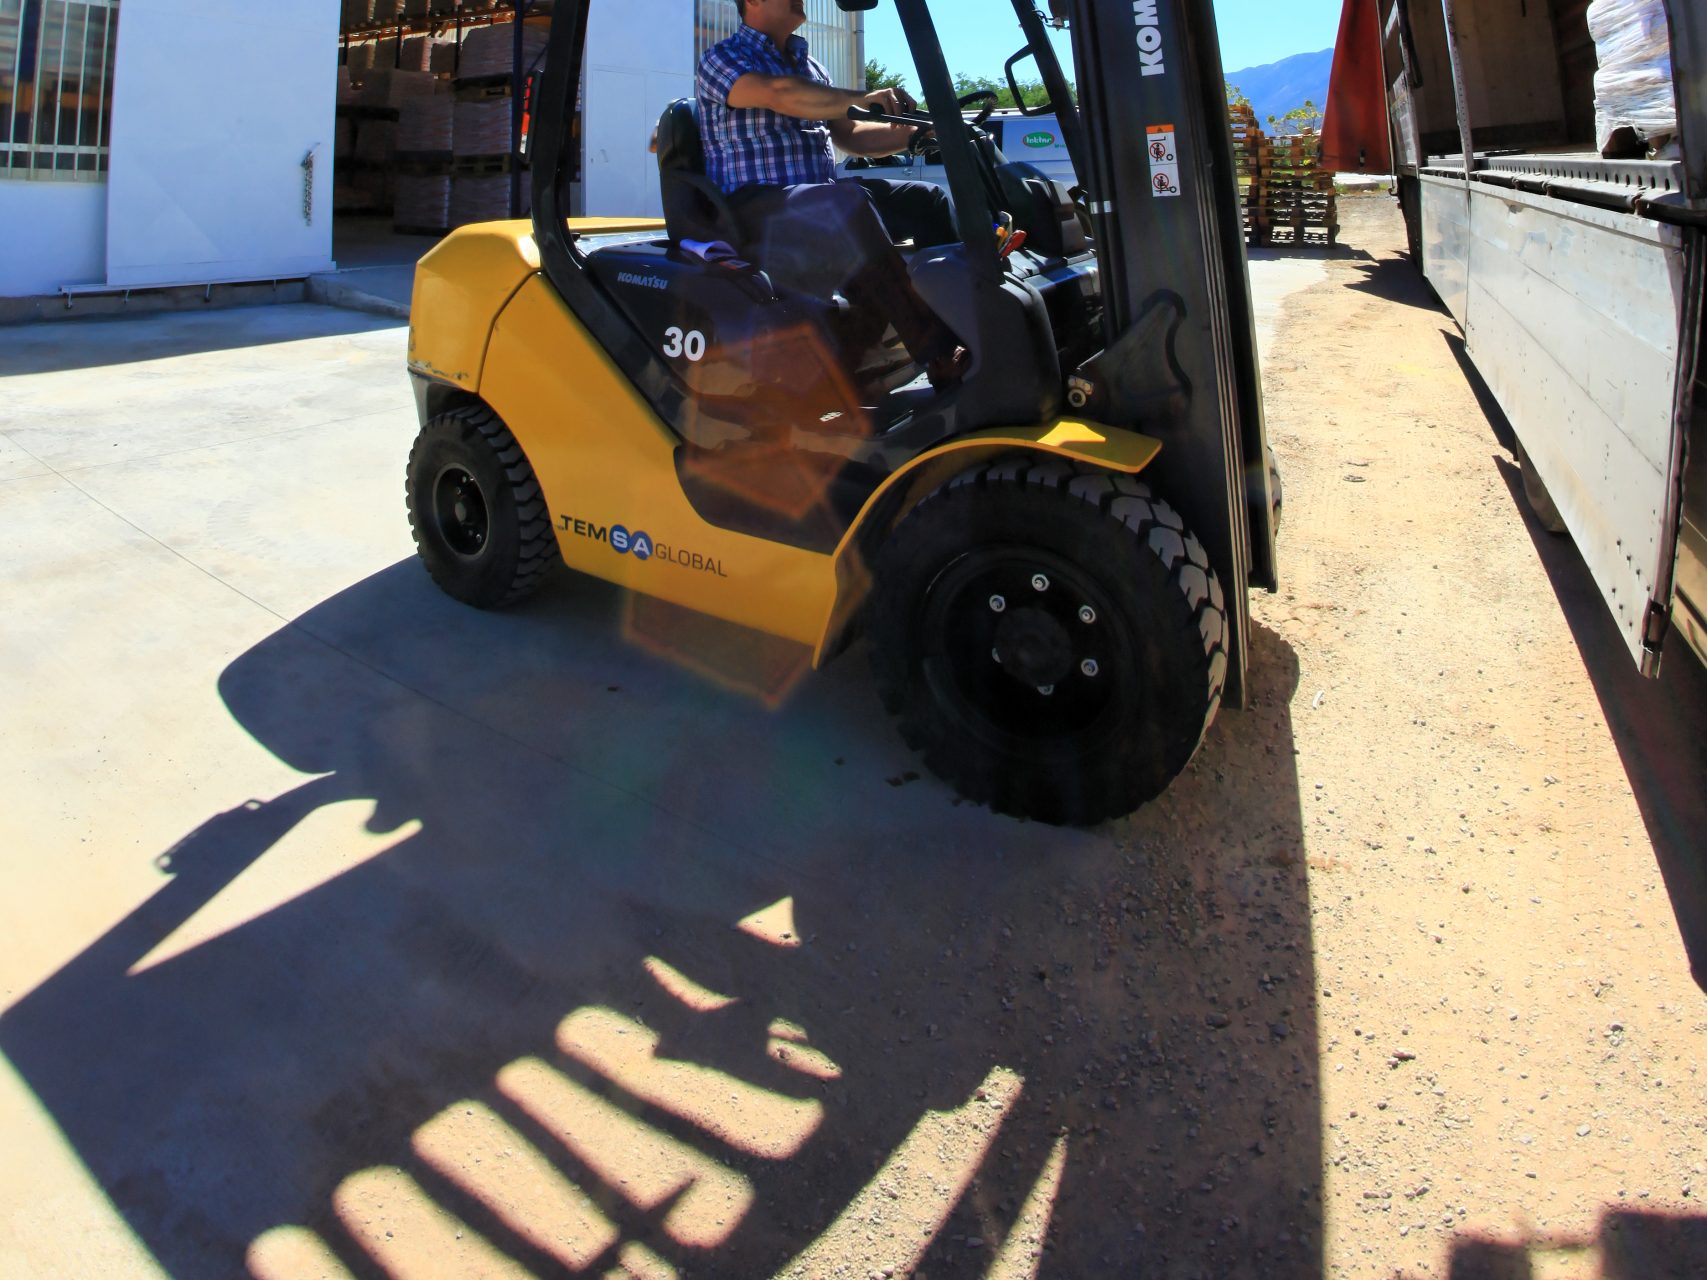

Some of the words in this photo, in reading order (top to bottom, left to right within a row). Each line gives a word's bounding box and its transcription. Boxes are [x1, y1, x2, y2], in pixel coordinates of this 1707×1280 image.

[617, 272, 668, 290] KOMATSU
[662, 326, 706, 361] 30
[560, 514, 653, 560] TEMSA
[655, 543, 728, 577] GLOBAL
